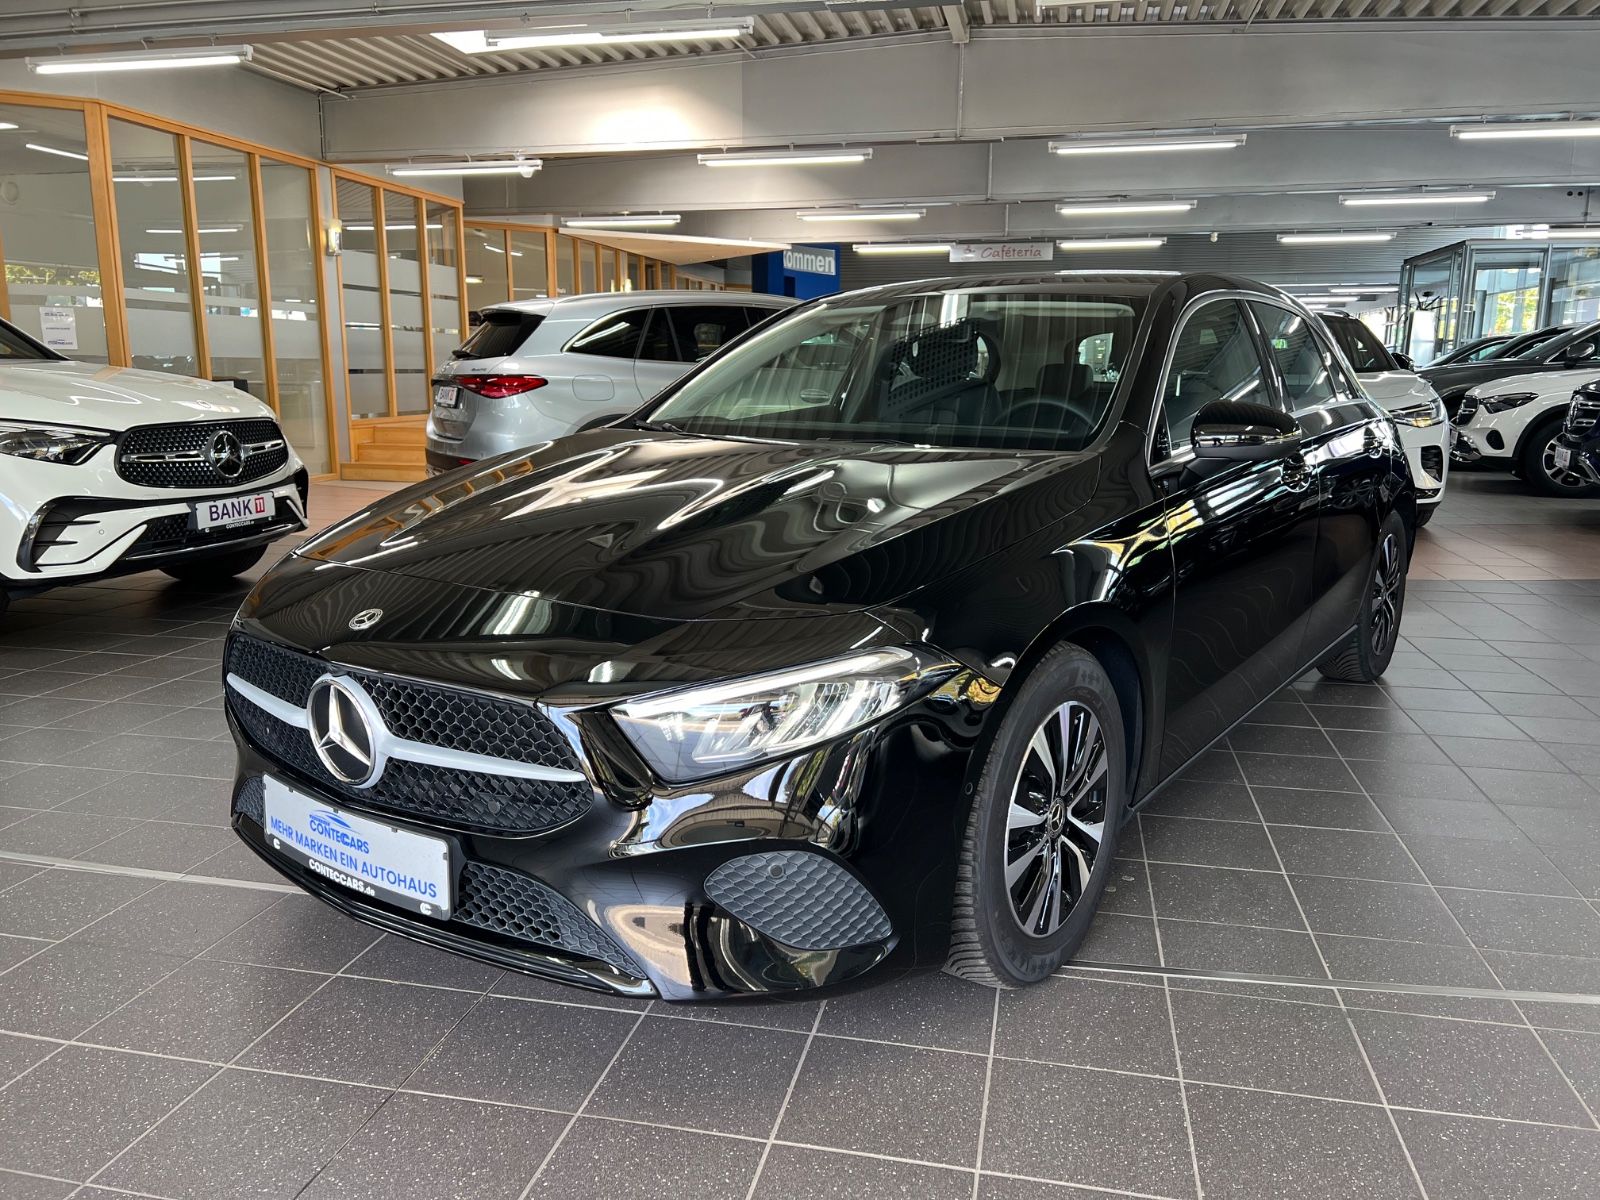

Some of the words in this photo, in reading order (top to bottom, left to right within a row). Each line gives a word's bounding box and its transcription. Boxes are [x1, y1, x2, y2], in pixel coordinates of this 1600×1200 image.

[209, 499, 252, 522] BANK
[270, 816, 294, 841] MEHR
[295, 830, 338, 863] MARKEN
[340, 852, 358, 871] EIN
[361, 862, 437, 898] AUTOHAUS
[308, 858, 375, 897] CONTECCARS.de
